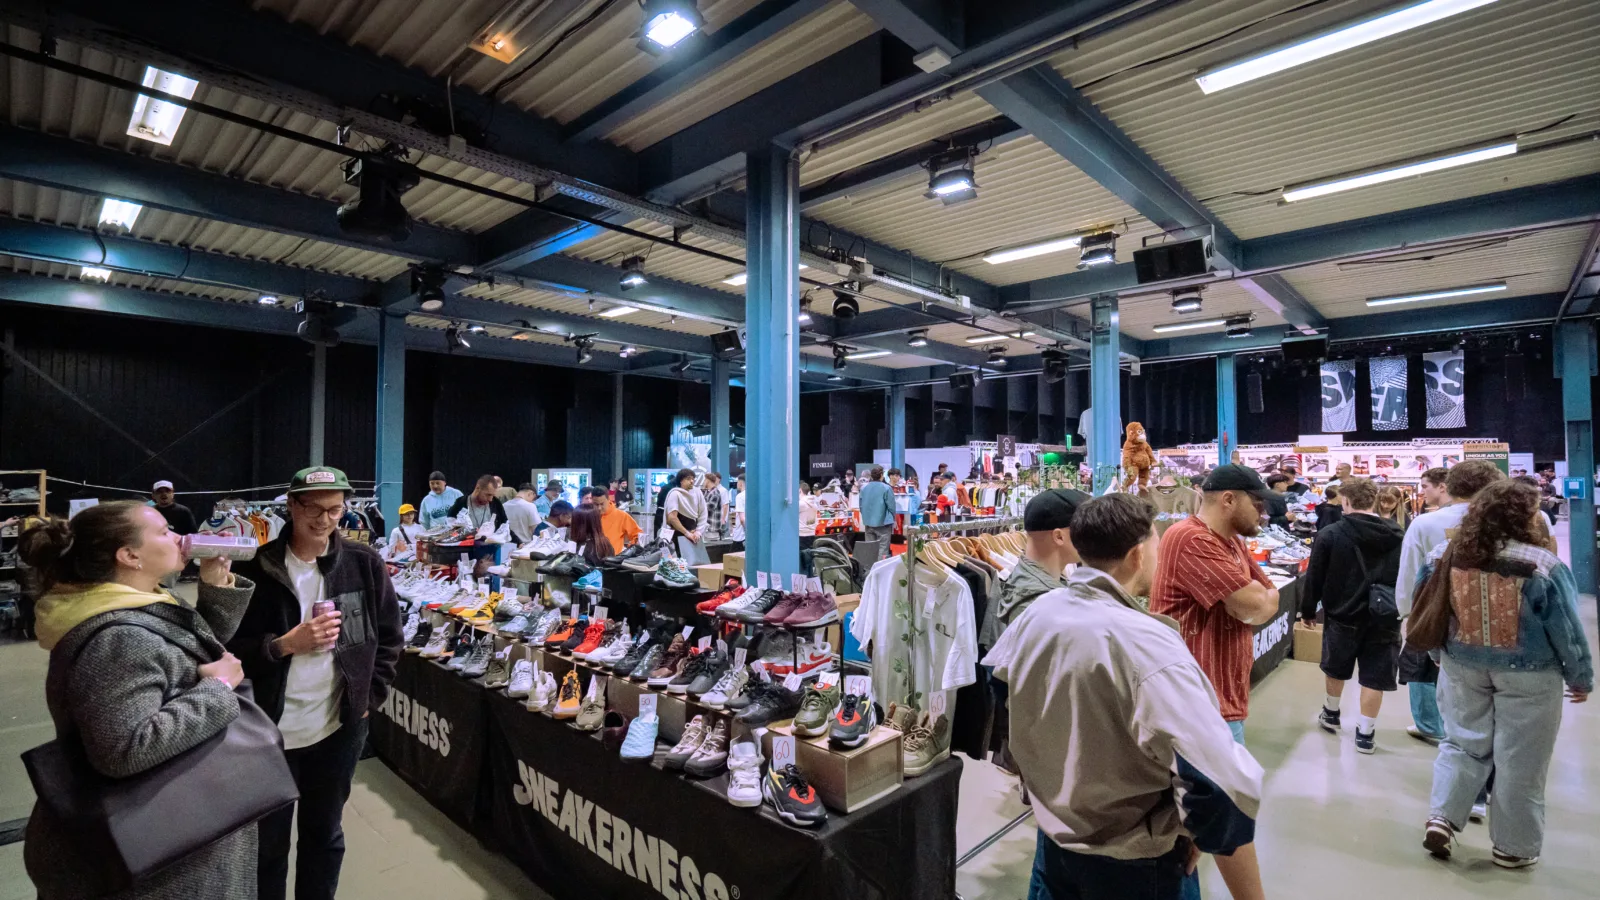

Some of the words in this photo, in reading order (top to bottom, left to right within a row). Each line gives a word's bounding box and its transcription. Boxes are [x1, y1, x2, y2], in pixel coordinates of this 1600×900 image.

[850, 678, 867, 695] 60
[931, 694, 944, 713] 60
[774, 739, 790, 761] 60
